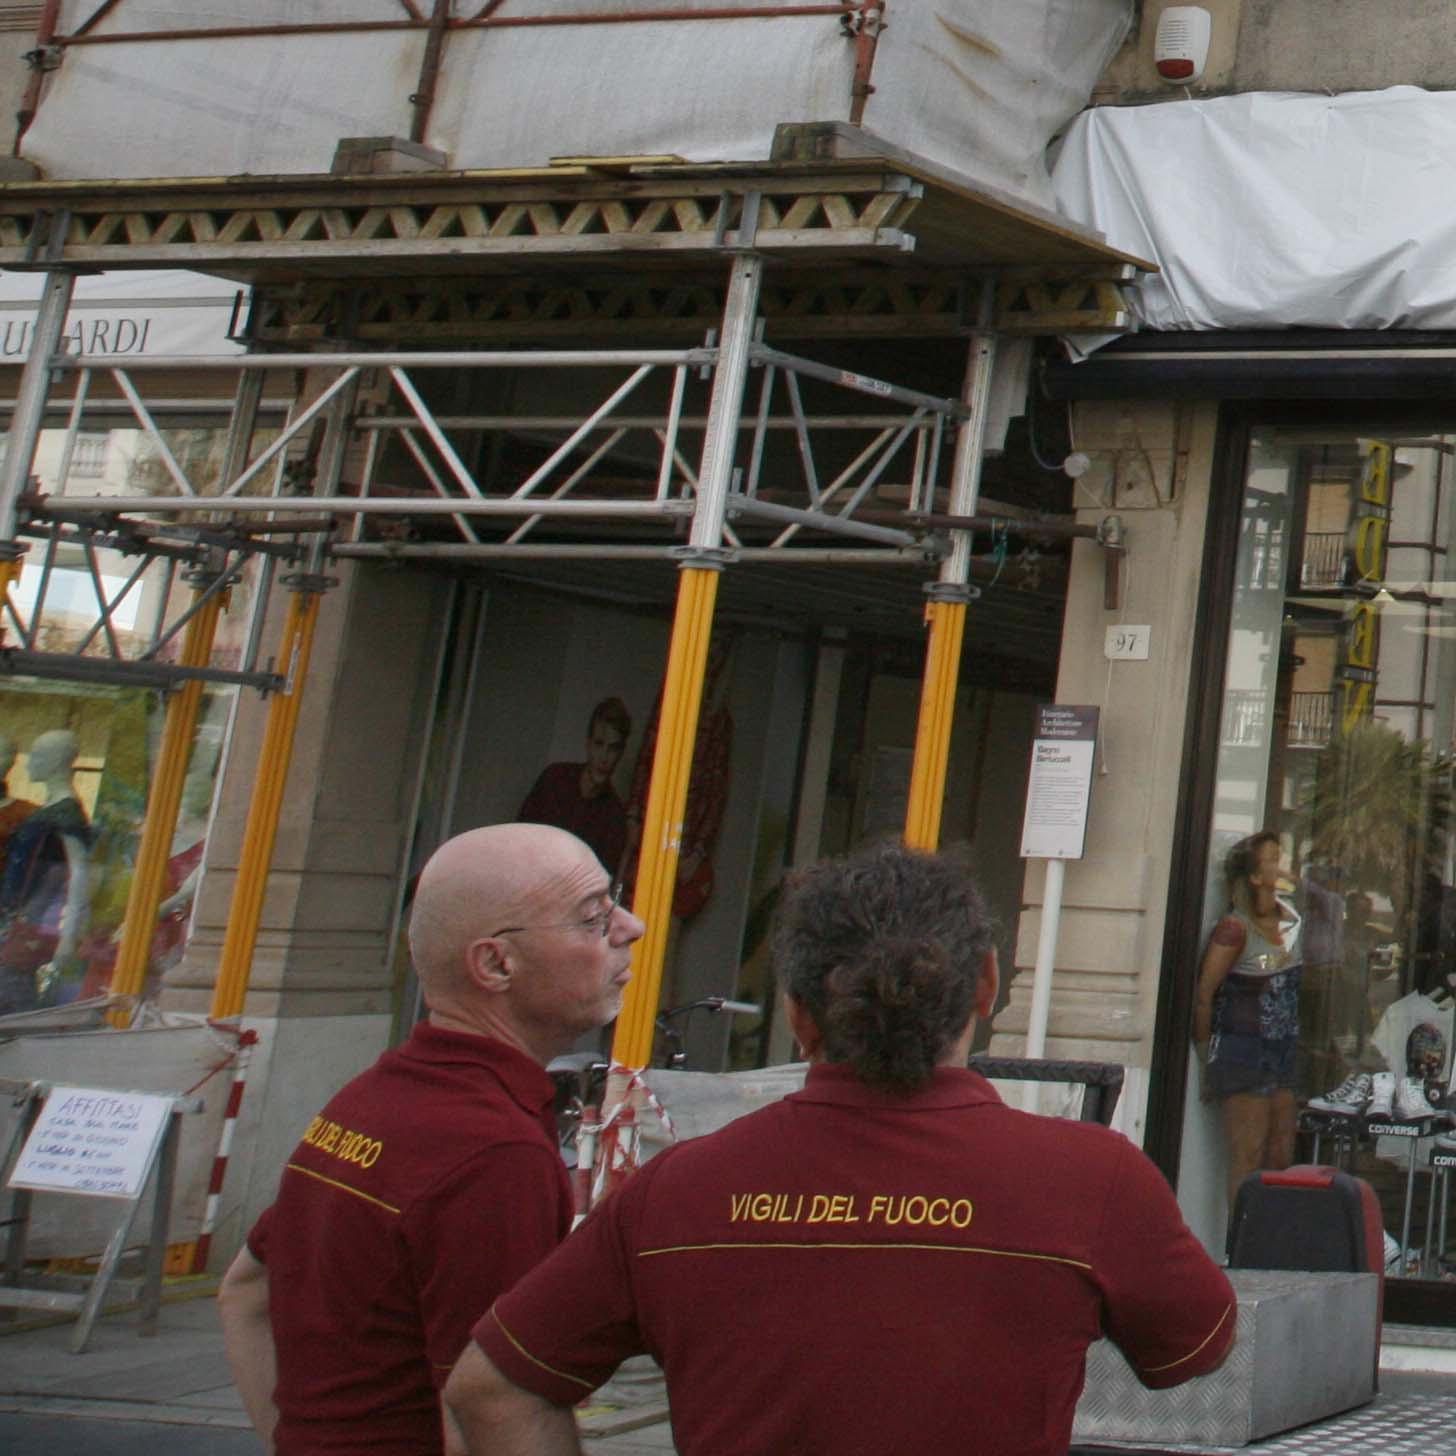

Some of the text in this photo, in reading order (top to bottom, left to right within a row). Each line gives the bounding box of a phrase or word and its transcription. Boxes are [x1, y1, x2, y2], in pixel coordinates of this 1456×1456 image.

[1115, 633, 1138, 652] 97
[1368, 1123, 1419, 1136] CONVERSE
[335, 1129, 383, 1168] FUOCO
[731, 1193, 973, 1228] VIGILI DEL FUOCO
